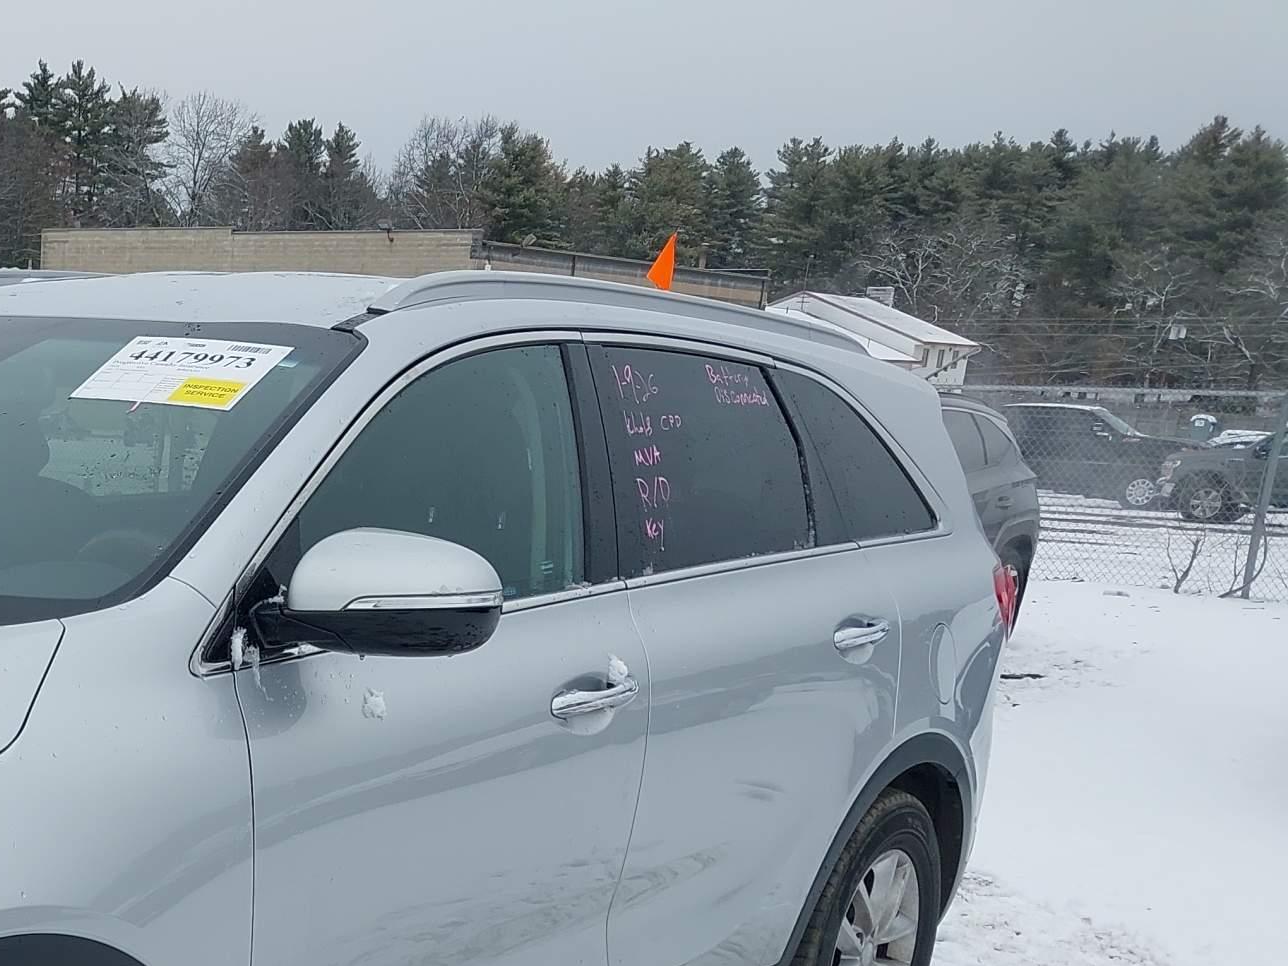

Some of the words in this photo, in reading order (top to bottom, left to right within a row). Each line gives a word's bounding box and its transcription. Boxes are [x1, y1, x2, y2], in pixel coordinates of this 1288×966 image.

[128, 349, 257, 369] 44179973
[183, 382, 240, 394] INSPECTION
[183, 389, 227, 399] SERVICE
[634, 444, 662, 467] MVA
[645, 518, 665, 552] Key
